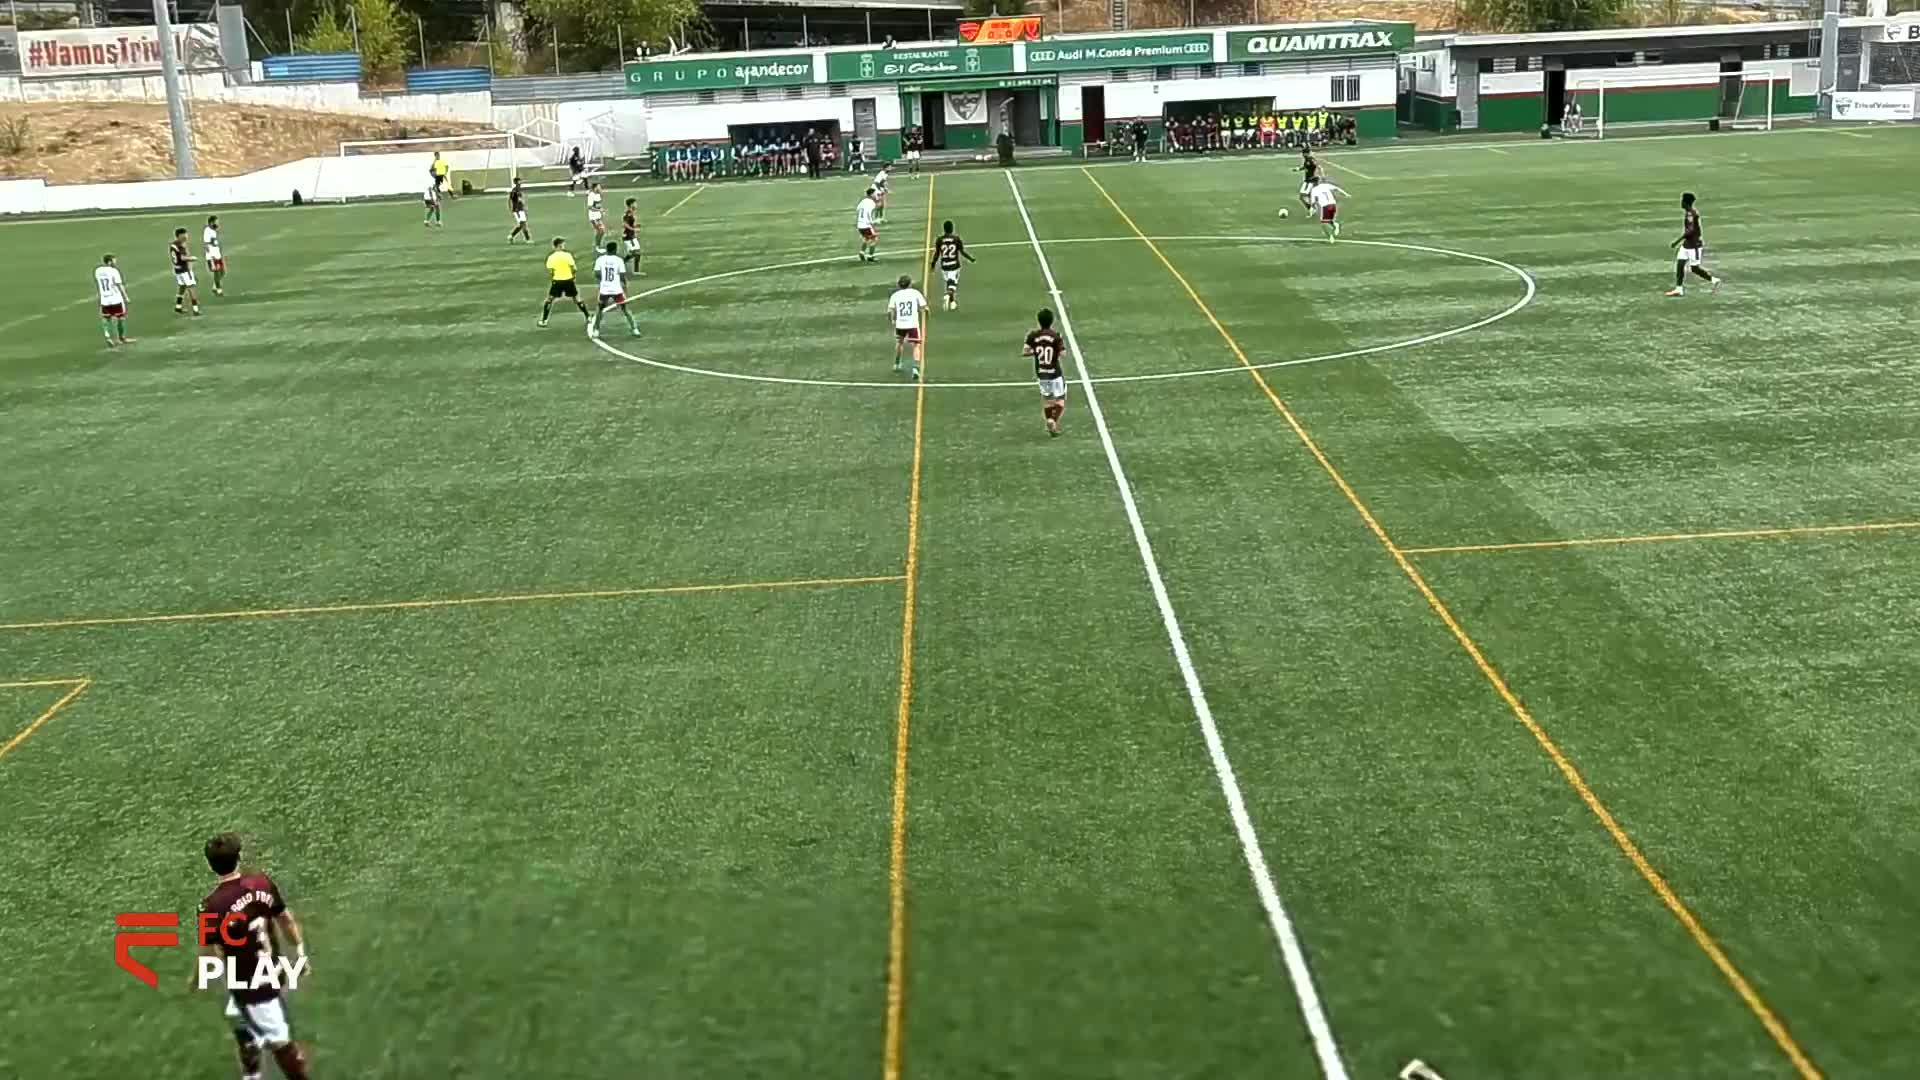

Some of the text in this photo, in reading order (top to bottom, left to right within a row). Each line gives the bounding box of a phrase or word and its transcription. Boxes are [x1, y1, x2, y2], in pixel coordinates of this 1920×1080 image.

[1247, 31, 1394, 53] QUAMTRAX
[893, 51, 950, 60] RESTAURANTE
[1057, 51, 1082, 60] Audi
[1135, 45, 1182, 57] Premium
[630, 68, 727, 83] GRUPO
[941, 244, 956, 259] 22
[899, 301, 912, 316] 23
[1035, 346, 1054, 365] 20
